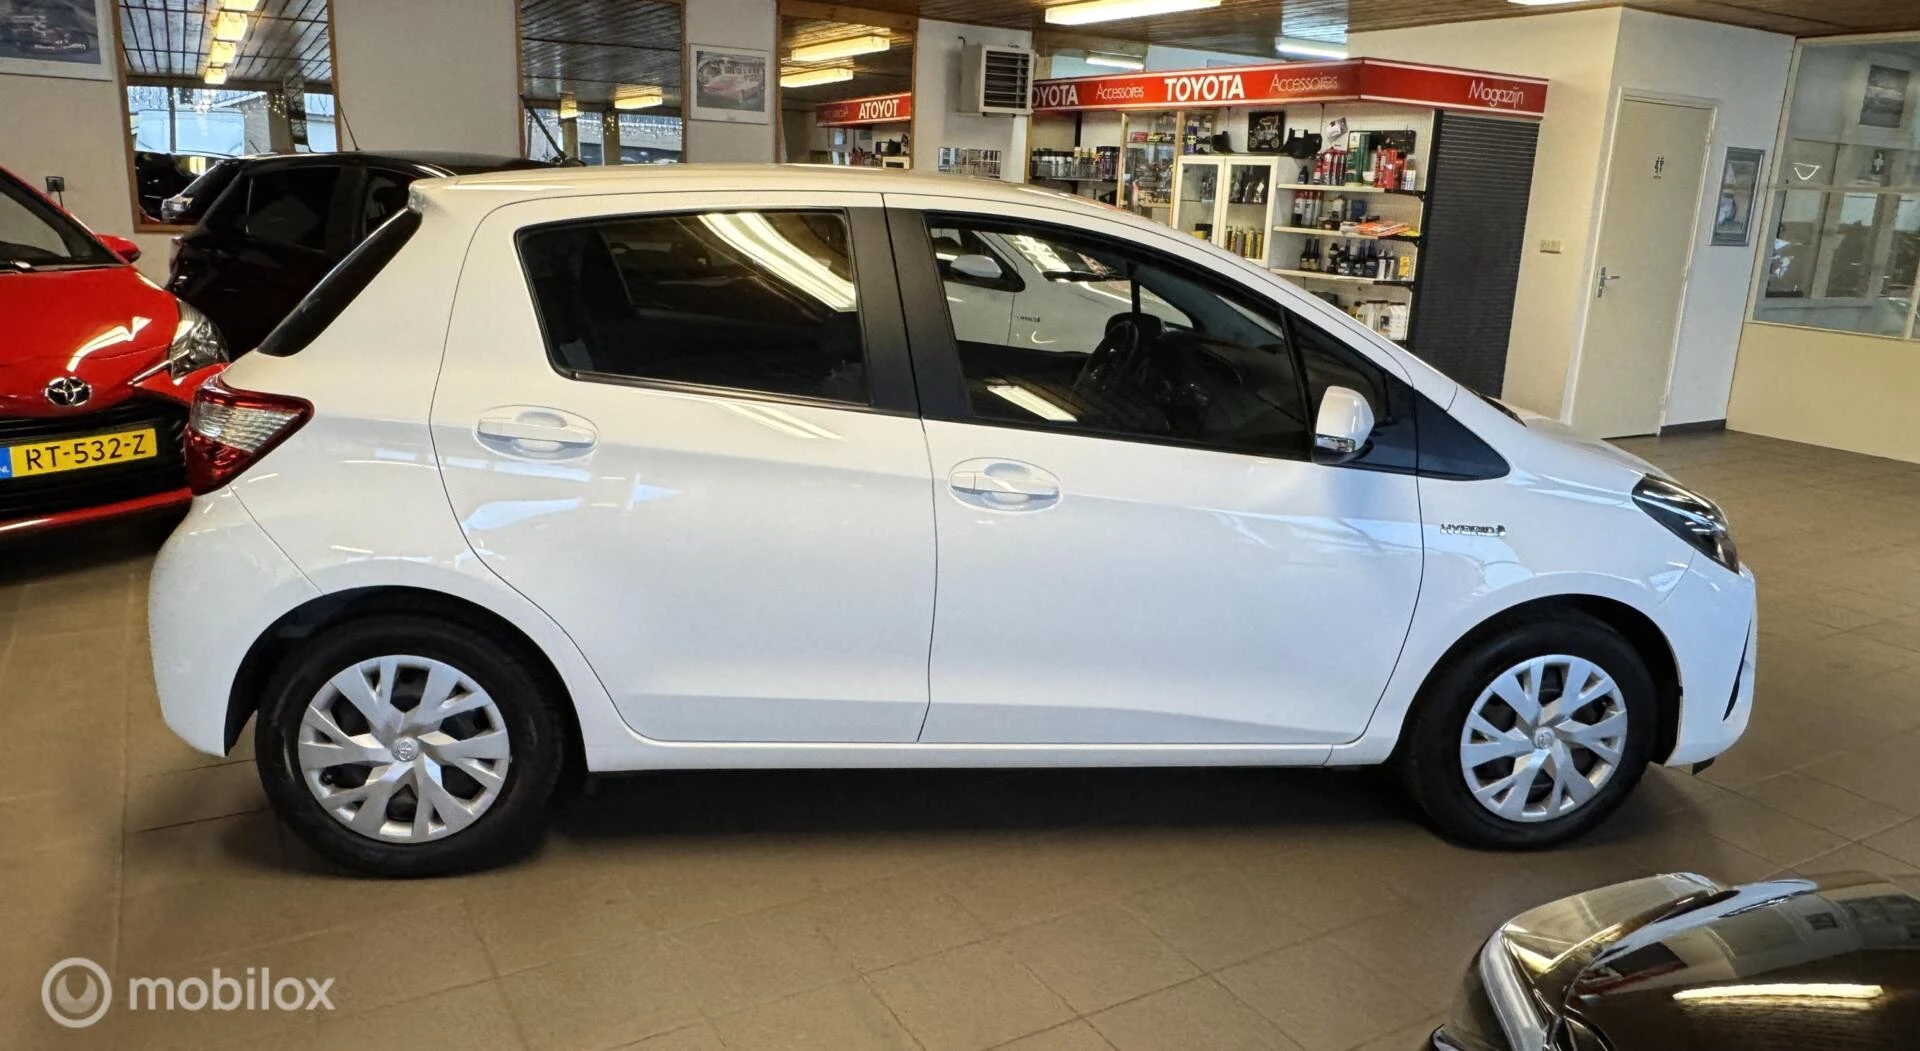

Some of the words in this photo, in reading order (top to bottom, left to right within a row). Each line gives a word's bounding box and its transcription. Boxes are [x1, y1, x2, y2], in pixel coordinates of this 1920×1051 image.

[1031, 84, 1079, 107] OYOTA
[1096, 83, 1145, 100] Accessoires
[1164, 74, 1245, 101] TOYOTA
[1269, 72, 1338, 93] Accessoires
[1468, 80, 1524, 109] Magazijn
[25, 433, 146, 471] RT-532-Z
